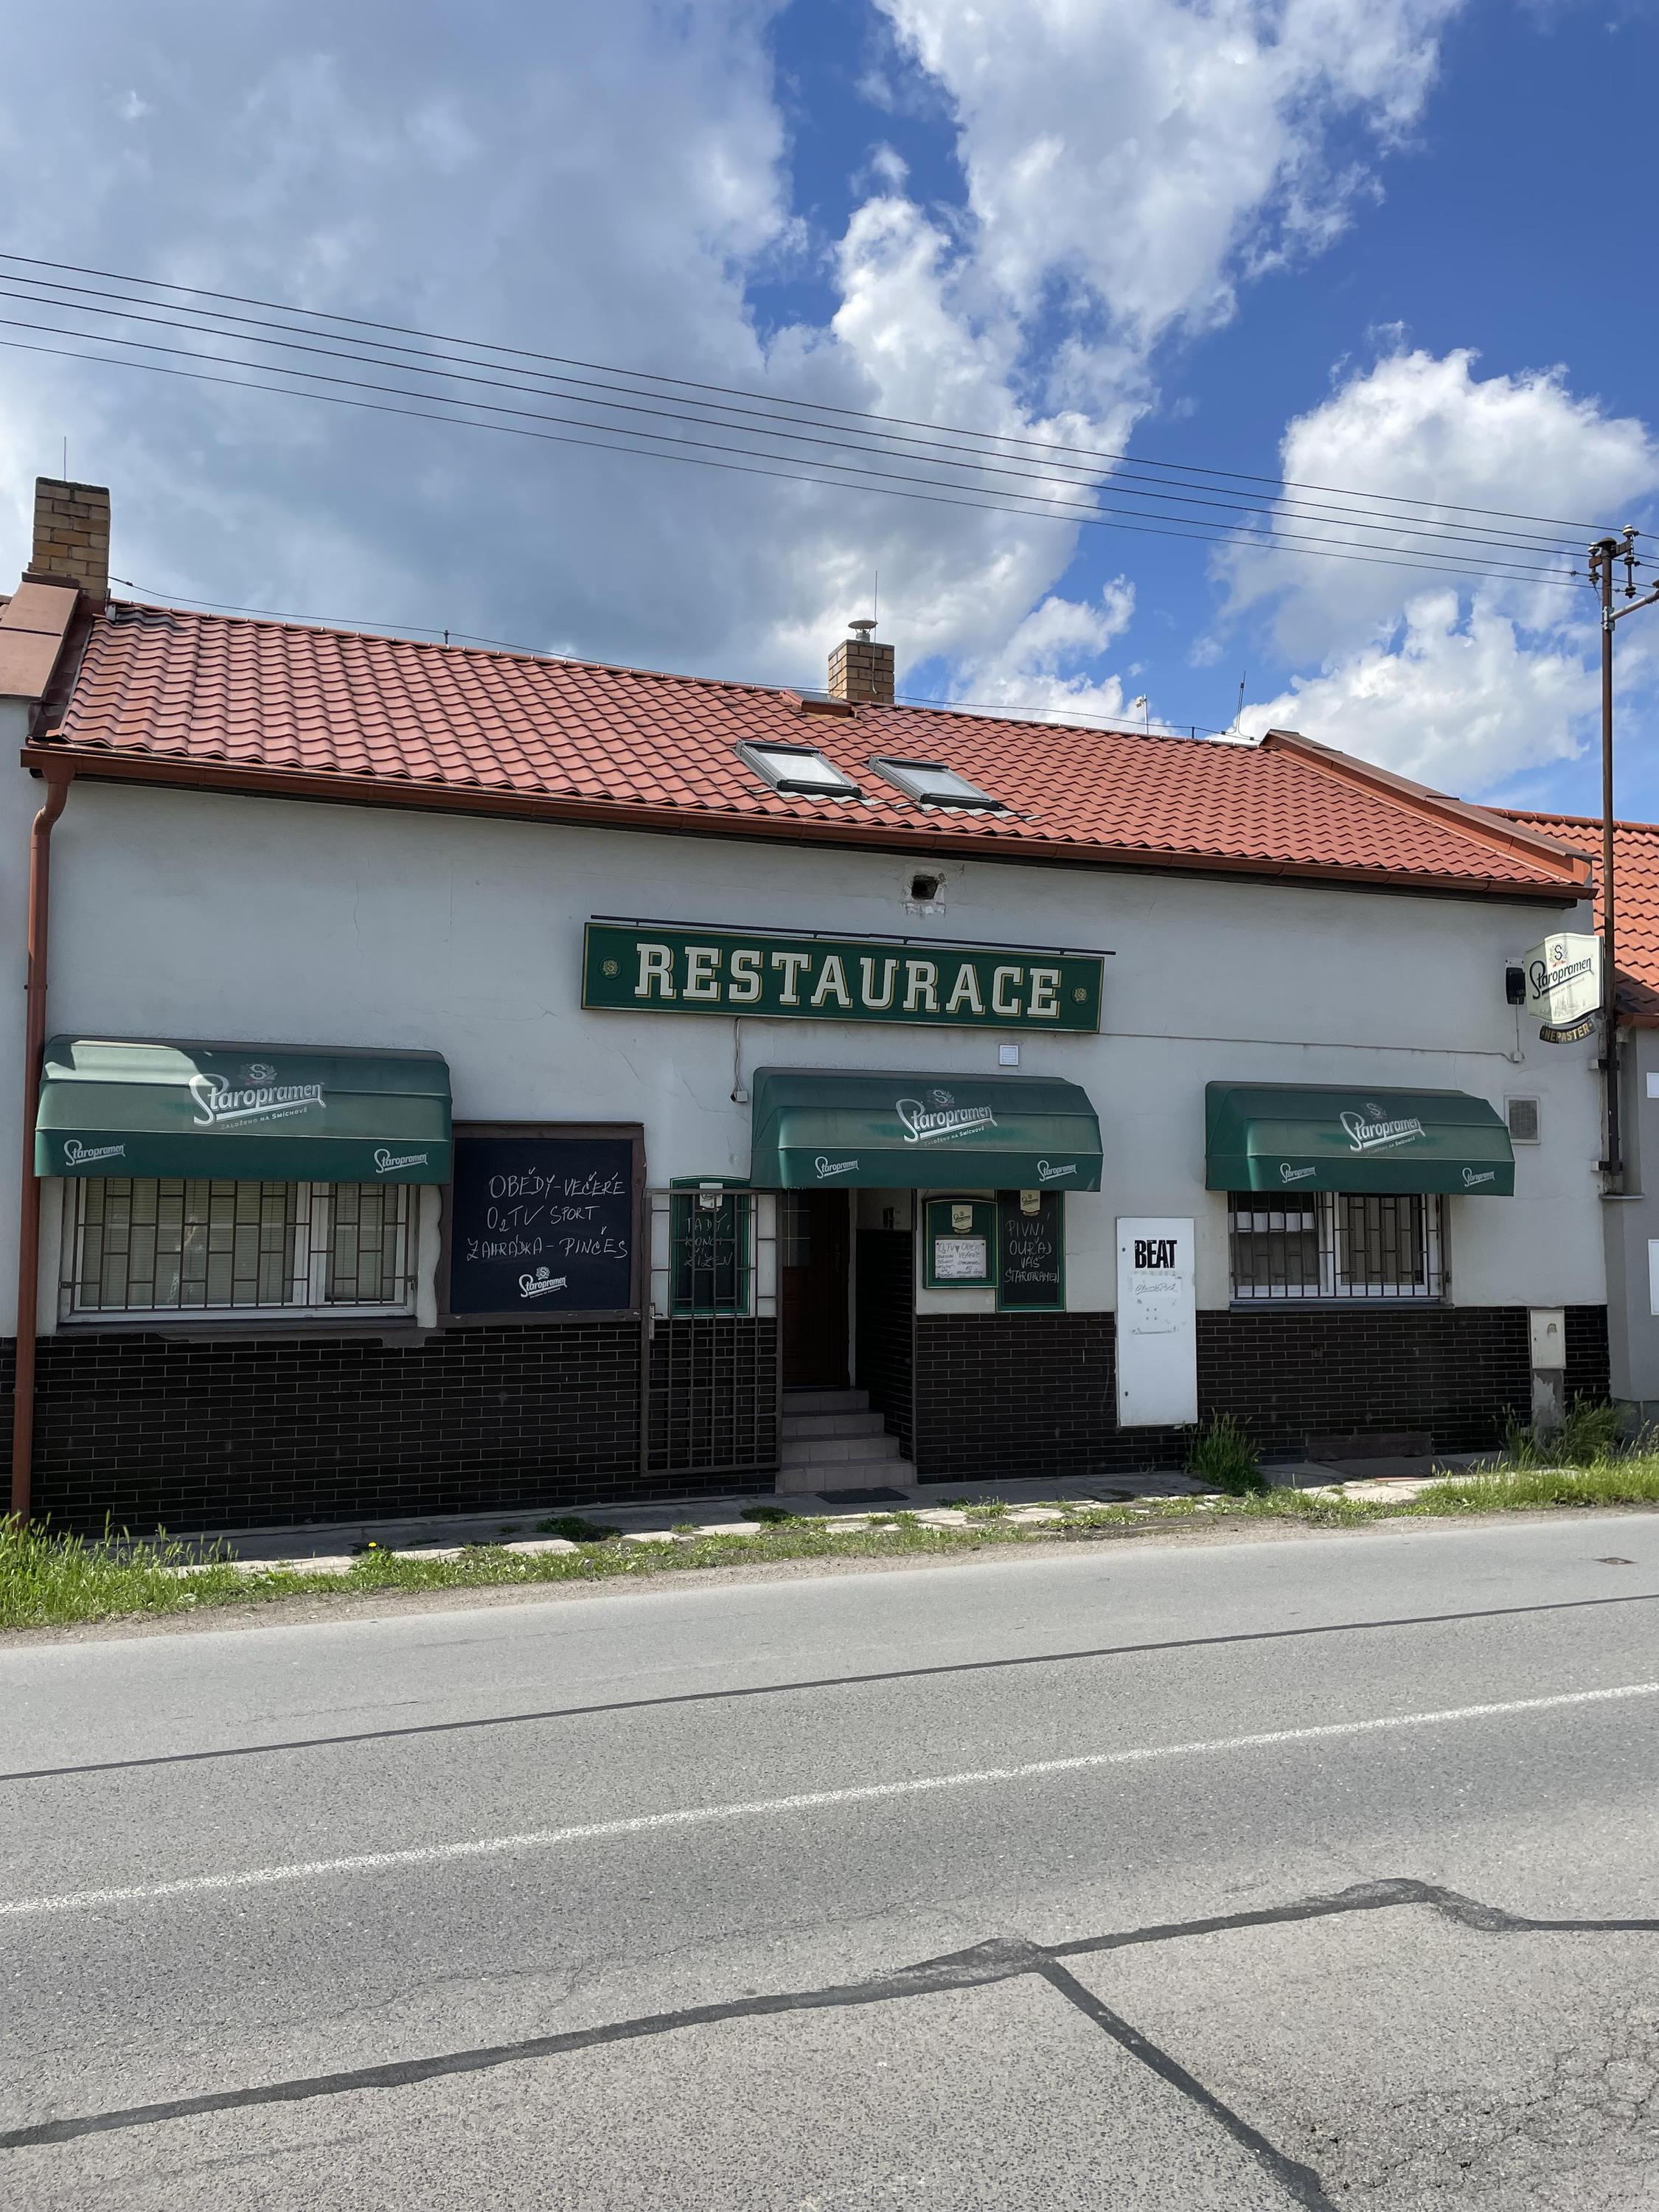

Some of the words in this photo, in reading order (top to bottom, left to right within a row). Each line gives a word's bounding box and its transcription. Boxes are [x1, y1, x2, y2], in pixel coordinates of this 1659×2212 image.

[633, 942, 1062, 1018] RESTAURACE
[1529, 958, 1594, 1000] Staropramen
[1544, 1023, 1590, 1043] NEPASTER
[189, 1074, 326, 1127] Staropramen
[895, 1099, 998, 1143] Staropramen
[1340, 1111, 1426, 1152] Staropramen
[63, 1139, 126, 1166] Staropramen
[374, 1149, 428, 1173] Staropramen
[815, 1156, 859, 1178] Staropramen
[1037, 1160, 1077, 1182] Staropramen
[1280, 1163, 1317, 1183] Staropramen
[550, 1206, 601, 1224] SPORT
[1005, 1212, 1051, 1238] PIVNÍ
[1134, 1239, 1178, 1269] BEAT
[518, 1274, 568, 1298] Staropramen
